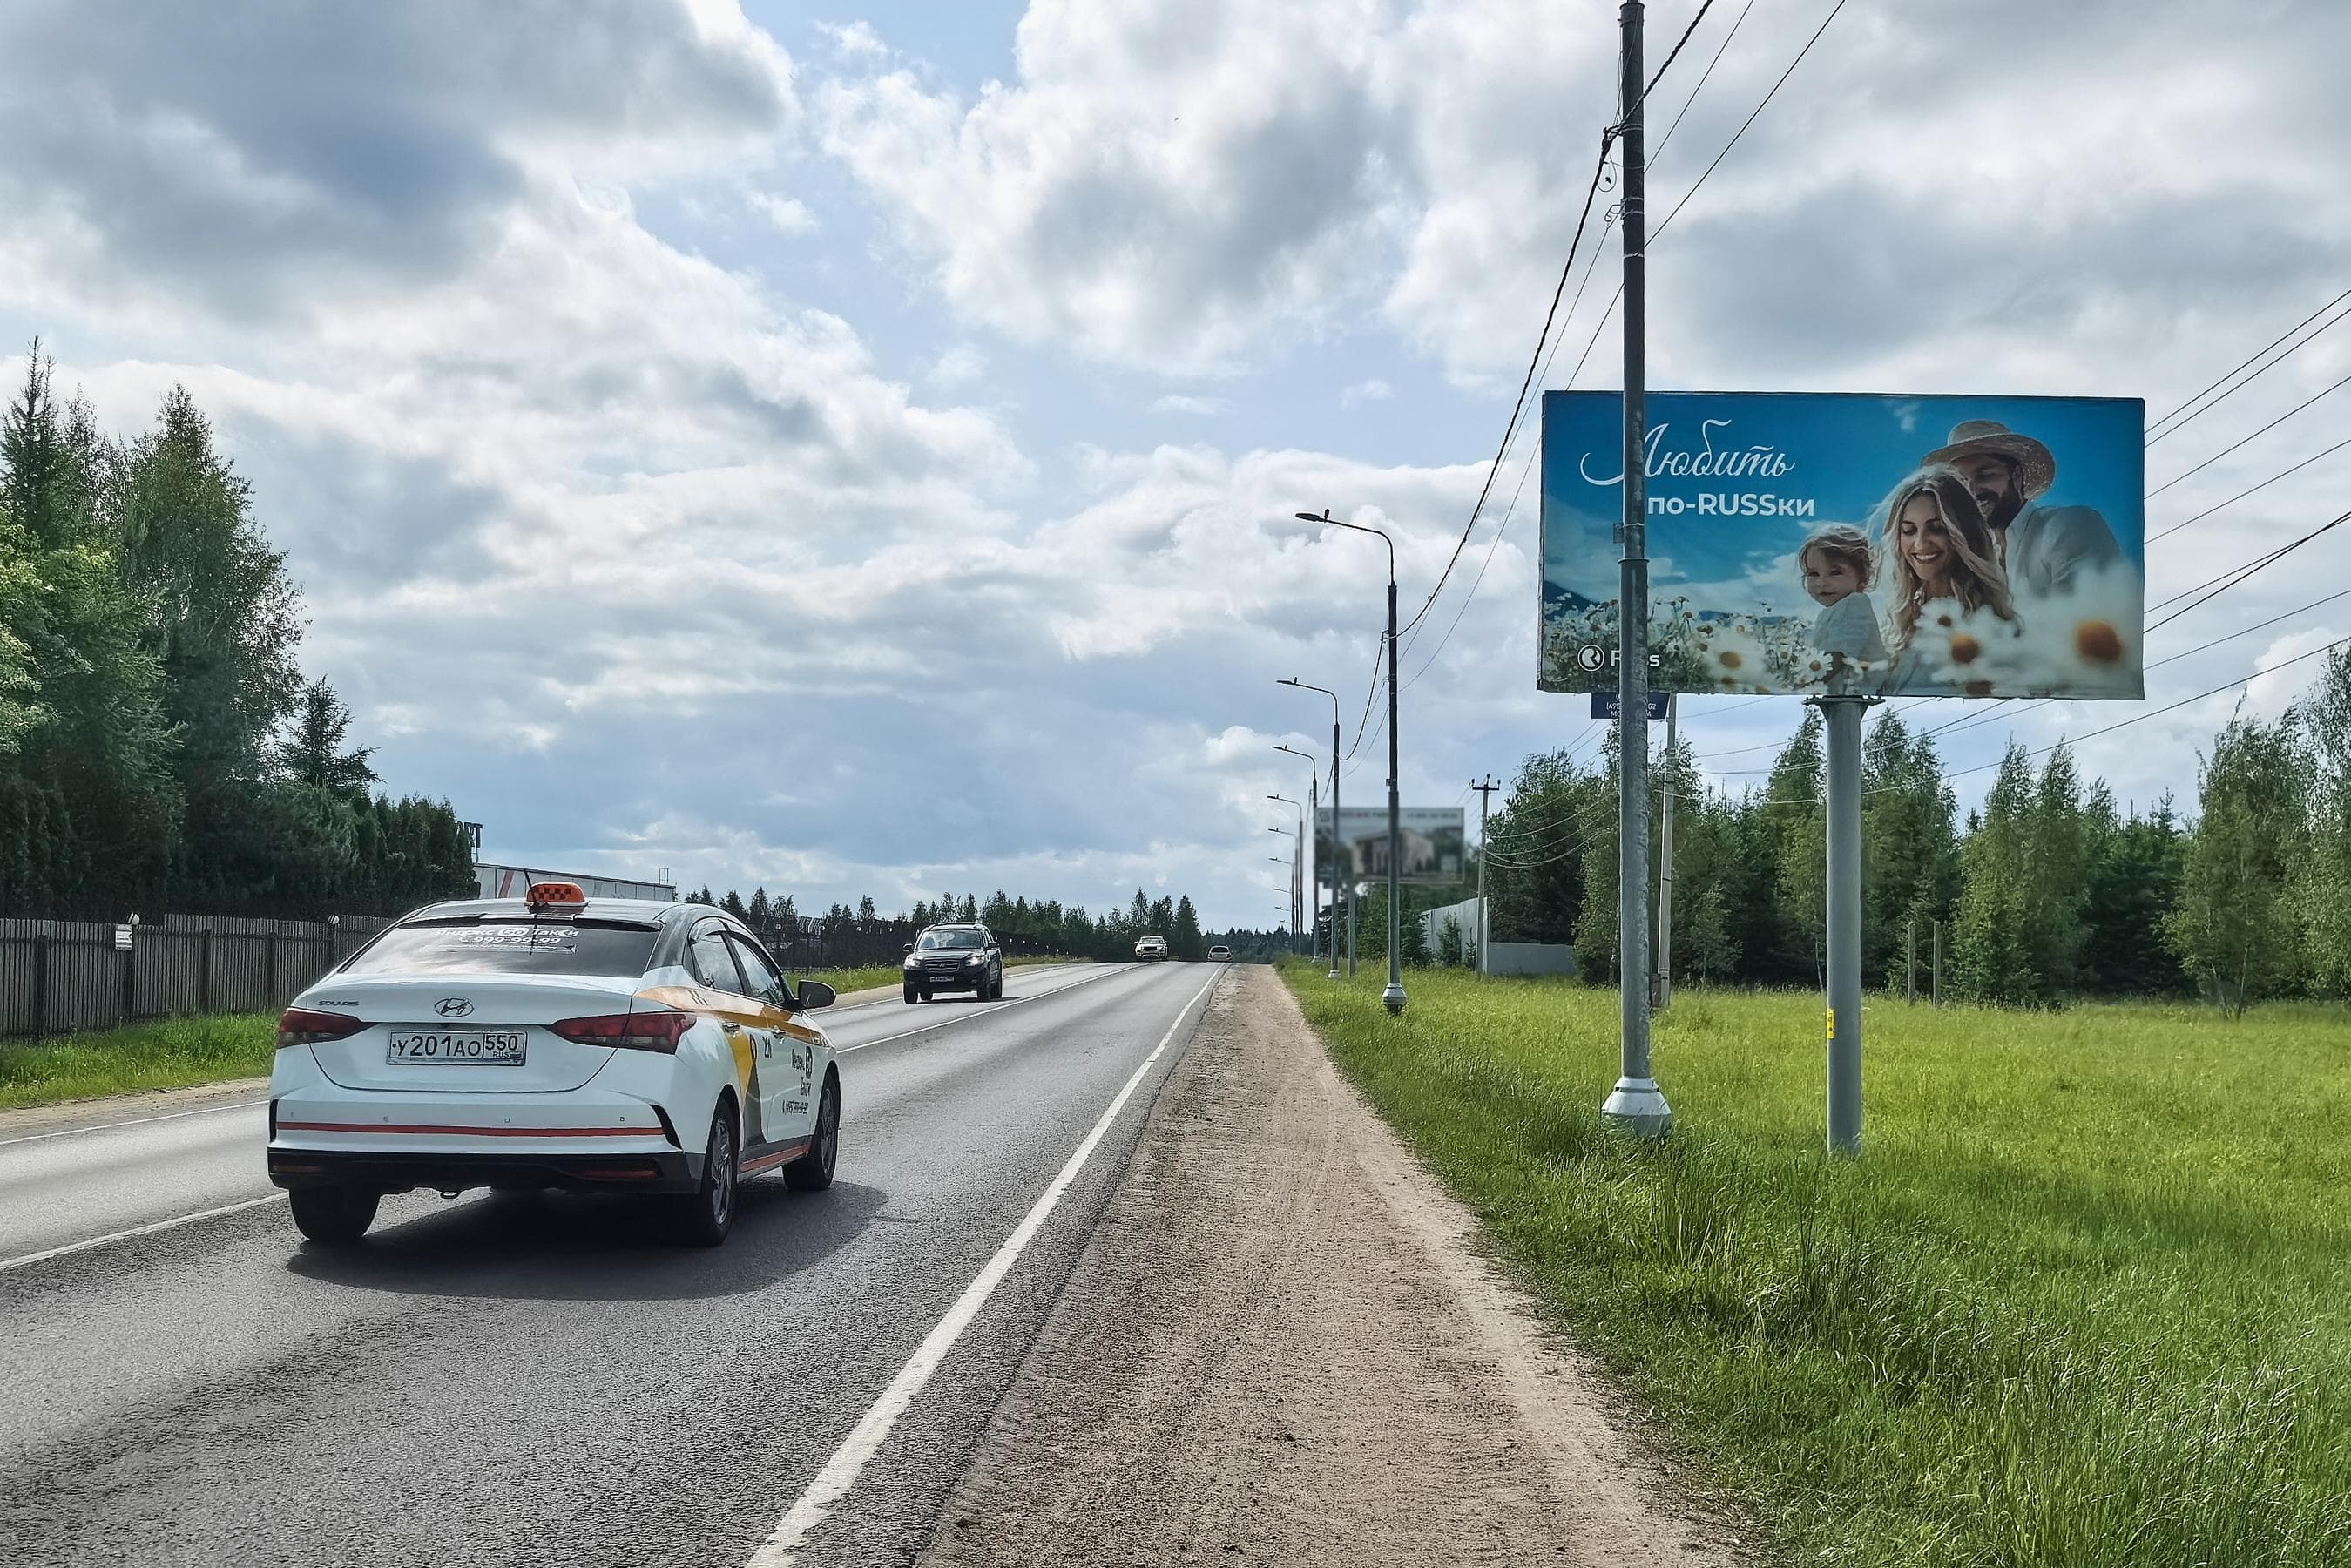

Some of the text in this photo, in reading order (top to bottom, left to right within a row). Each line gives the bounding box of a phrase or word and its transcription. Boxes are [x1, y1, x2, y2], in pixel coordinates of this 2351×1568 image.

[1579, 419, 1795, 486] Любить
[1647, 493, 1815, 517] по-RUSSки
[484, 1034, 518, 1051] 550
